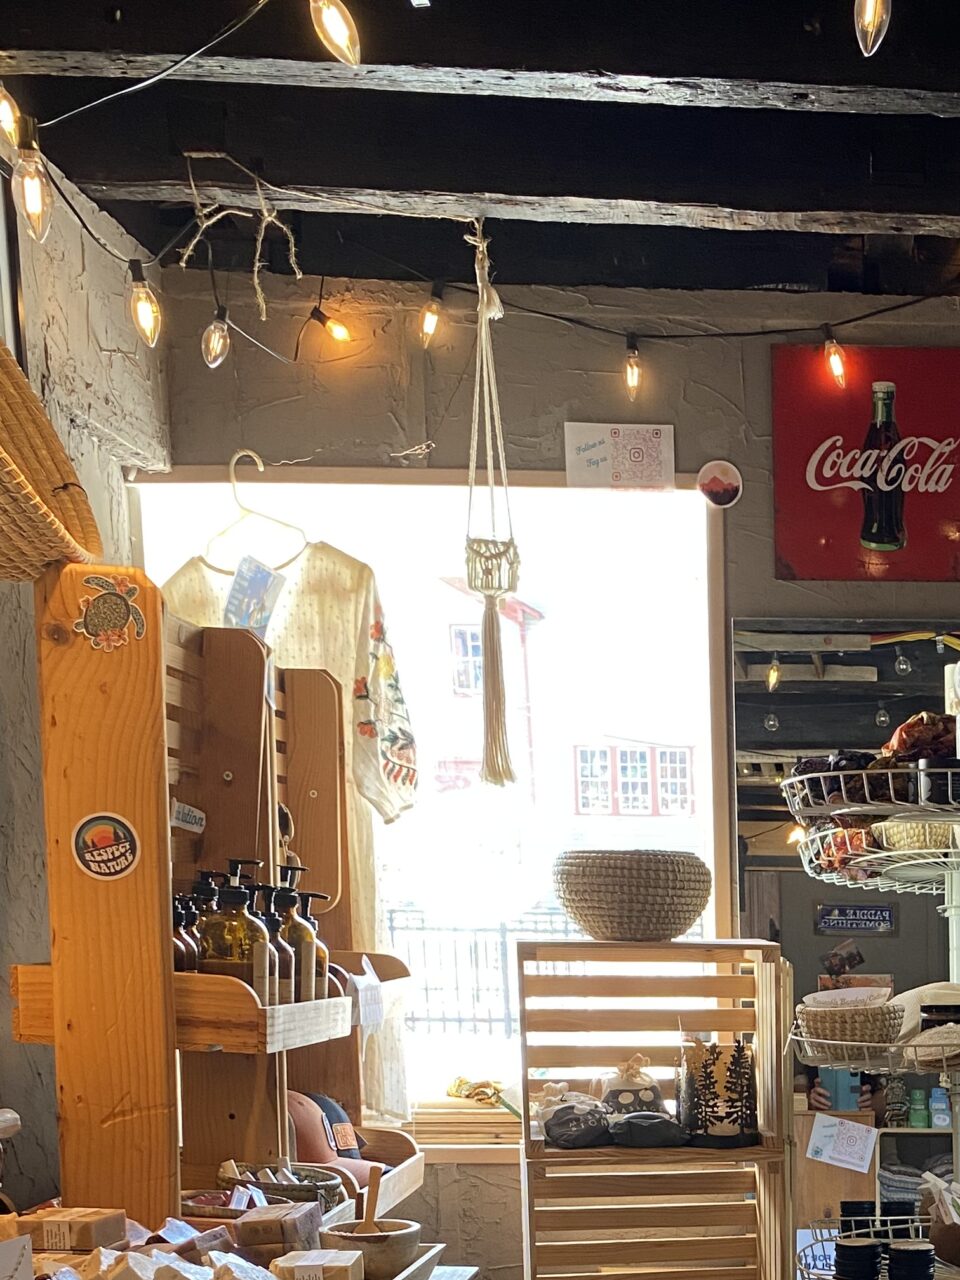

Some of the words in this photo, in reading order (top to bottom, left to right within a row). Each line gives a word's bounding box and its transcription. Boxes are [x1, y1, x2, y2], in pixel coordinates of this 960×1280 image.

[805, 435, 960, 493] Coca-Cola
[84, 841, 131, 861] RESPECT
[88, 850, 134, 873] NATURE
